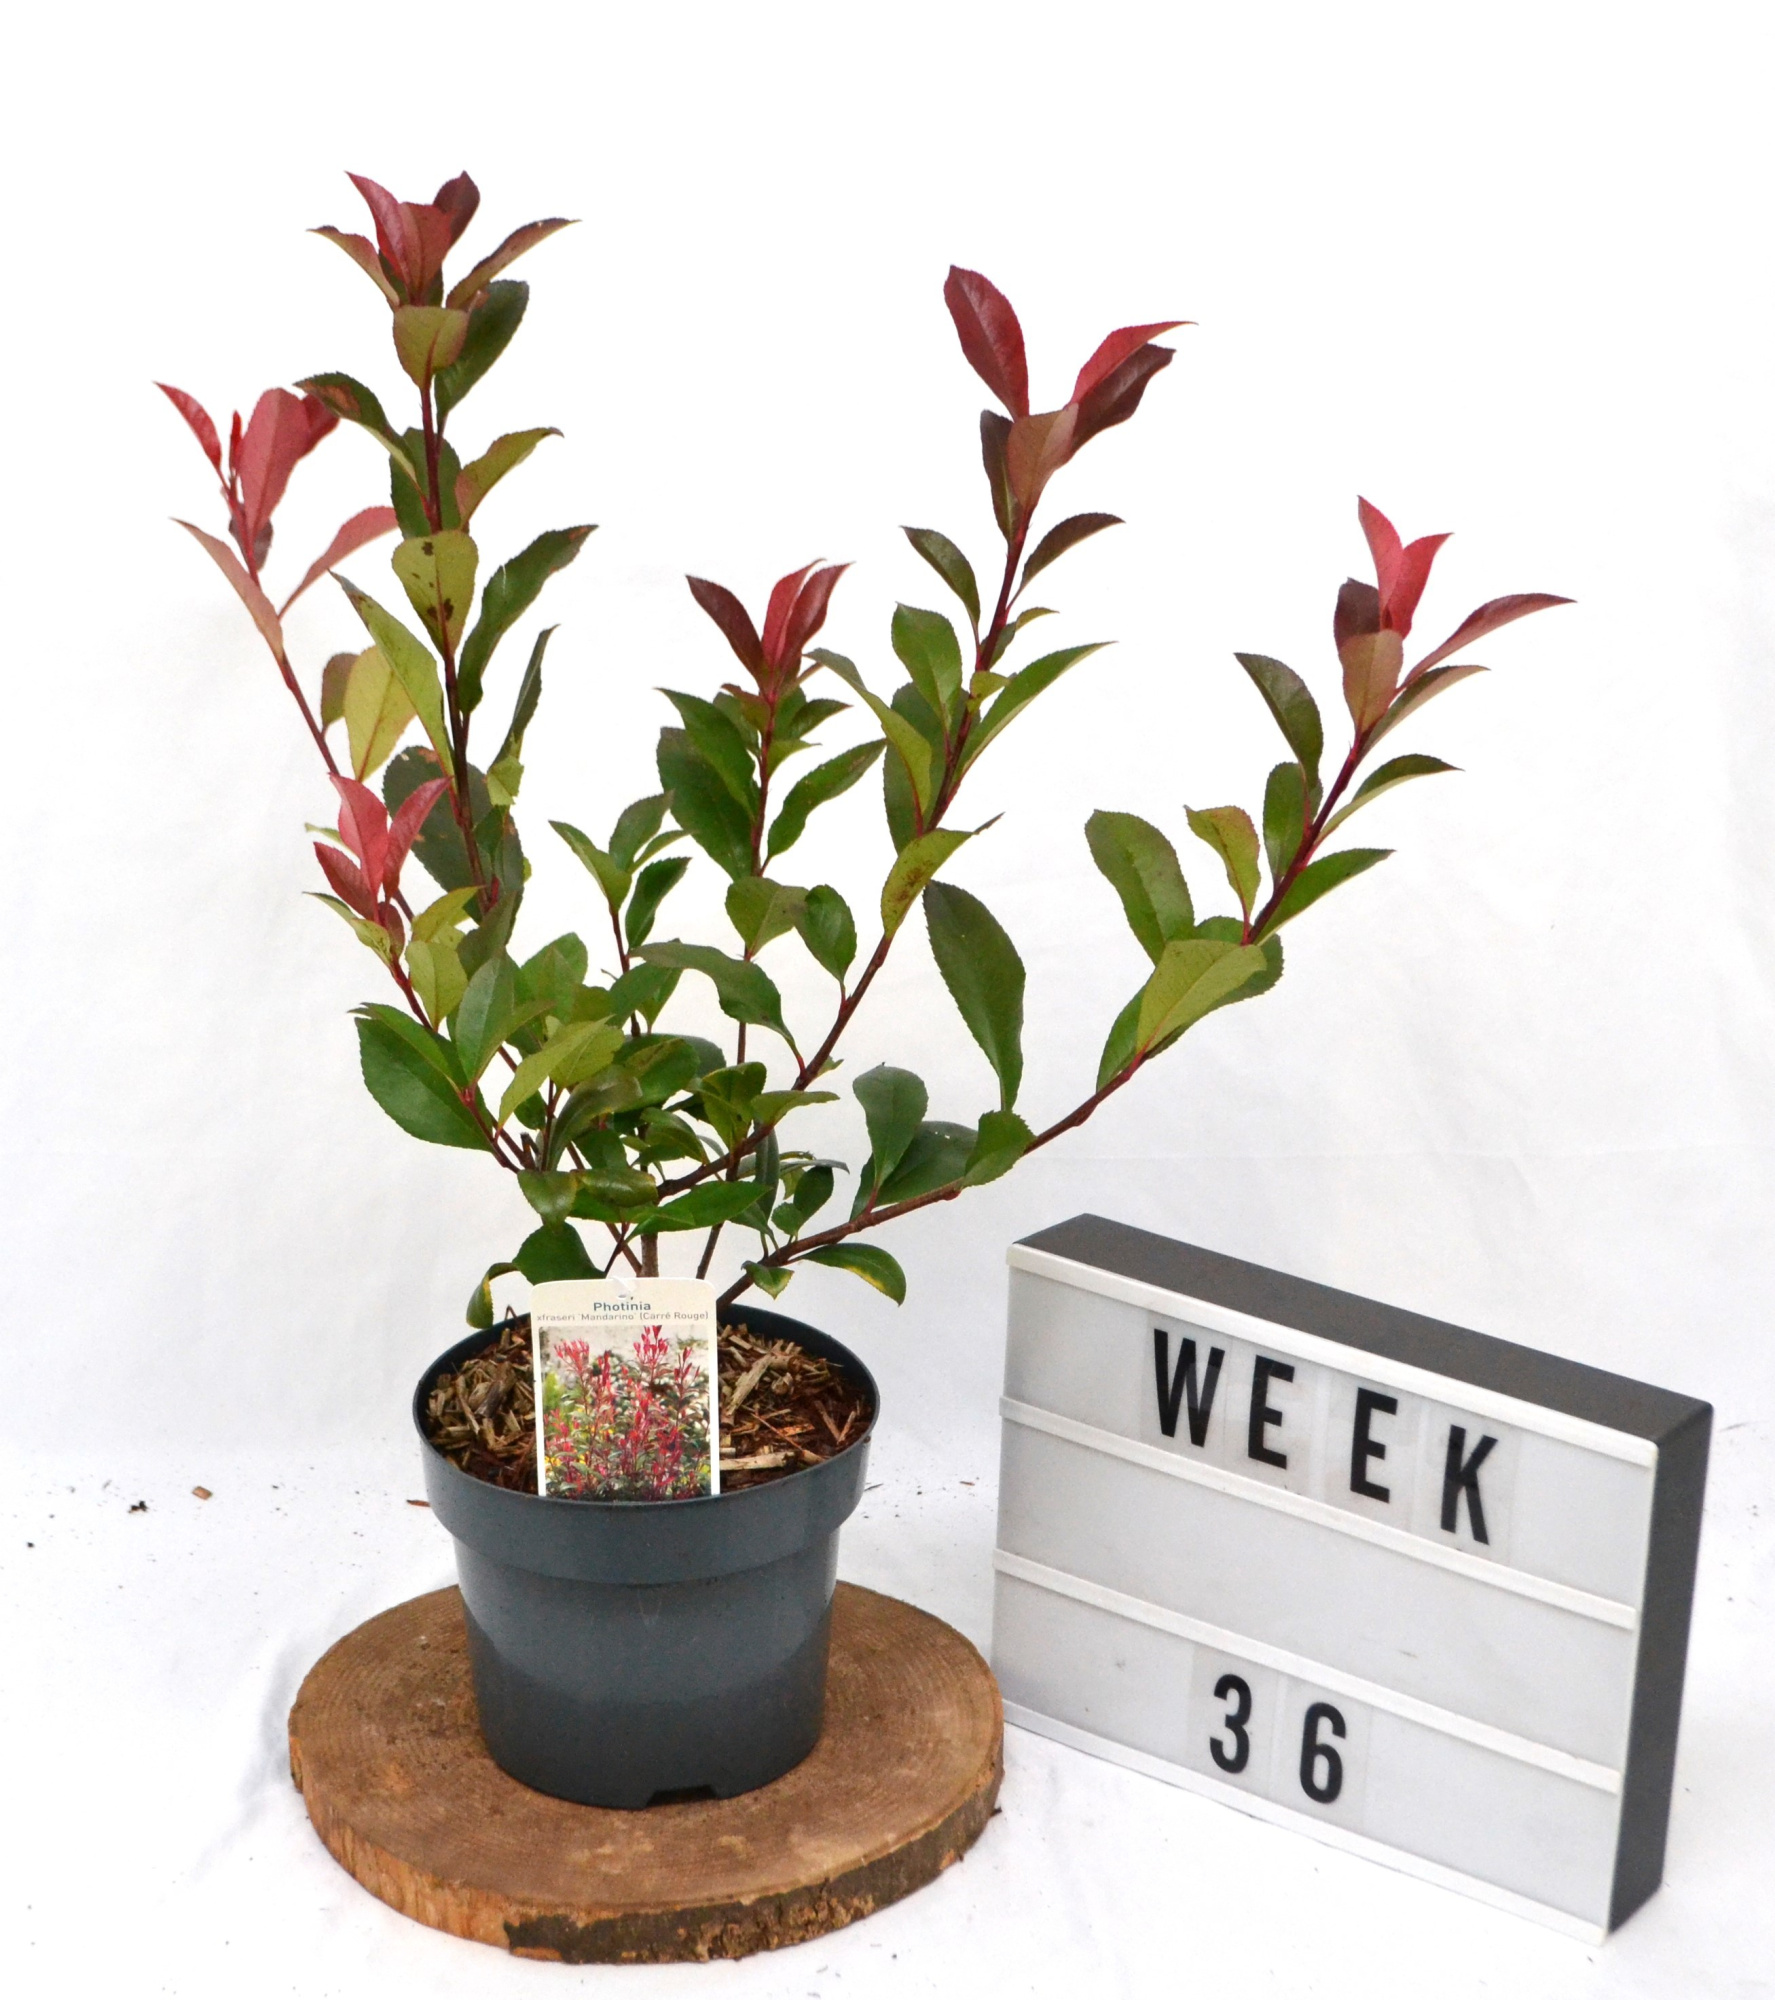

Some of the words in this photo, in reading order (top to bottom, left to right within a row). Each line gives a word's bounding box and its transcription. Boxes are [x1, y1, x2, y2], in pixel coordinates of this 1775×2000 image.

[536, 1313, 576, 1322] xfraseri
[639, 1311, 671, 1321] (Carré
[674, 1311, 709, 1321] Rouge)
[593, 1301, 652, 1312] Photinia
[1153, 1329, 1498, 1545] WEEK
[1209, 1674, 1347, 1804] 36
